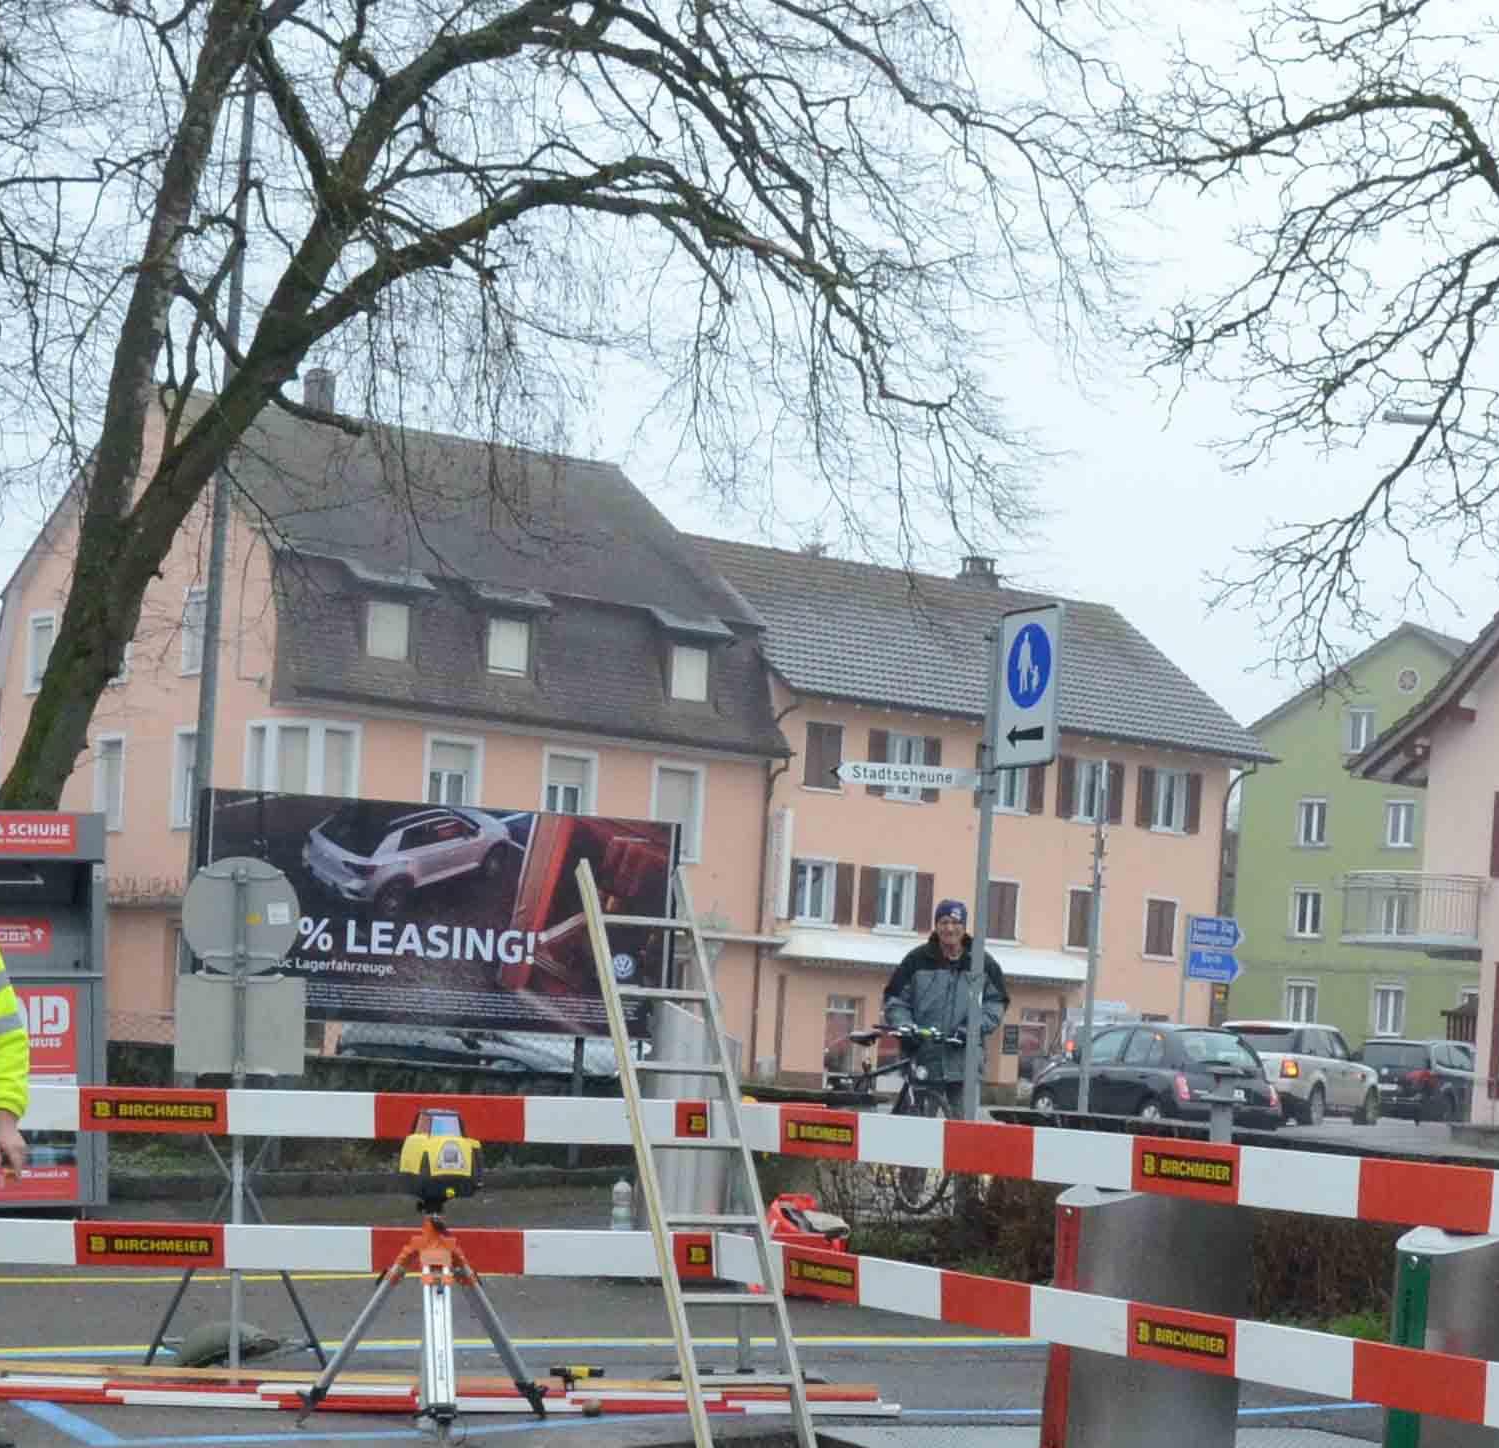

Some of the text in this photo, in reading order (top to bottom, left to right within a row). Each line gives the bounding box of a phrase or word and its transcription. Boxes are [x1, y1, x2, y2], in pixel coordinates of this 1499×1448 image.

[852, 766, 953, 784] Stadtscheune
[6, 823, 71, 837] SCHUHE
[346, 920, 535, 965] LEASING!
[295, 957, 397, 977] Lagerfahrzeuge.
[118, 1102, 214, 1119] BIRCHMEIER
[1160, 1158, 1232, 1182] BIRCHMEIER
[114, 1238, 209, 1254] BIRCHMEIER
[1154, 1327, 1226, 1354] BIRCHMEIER
